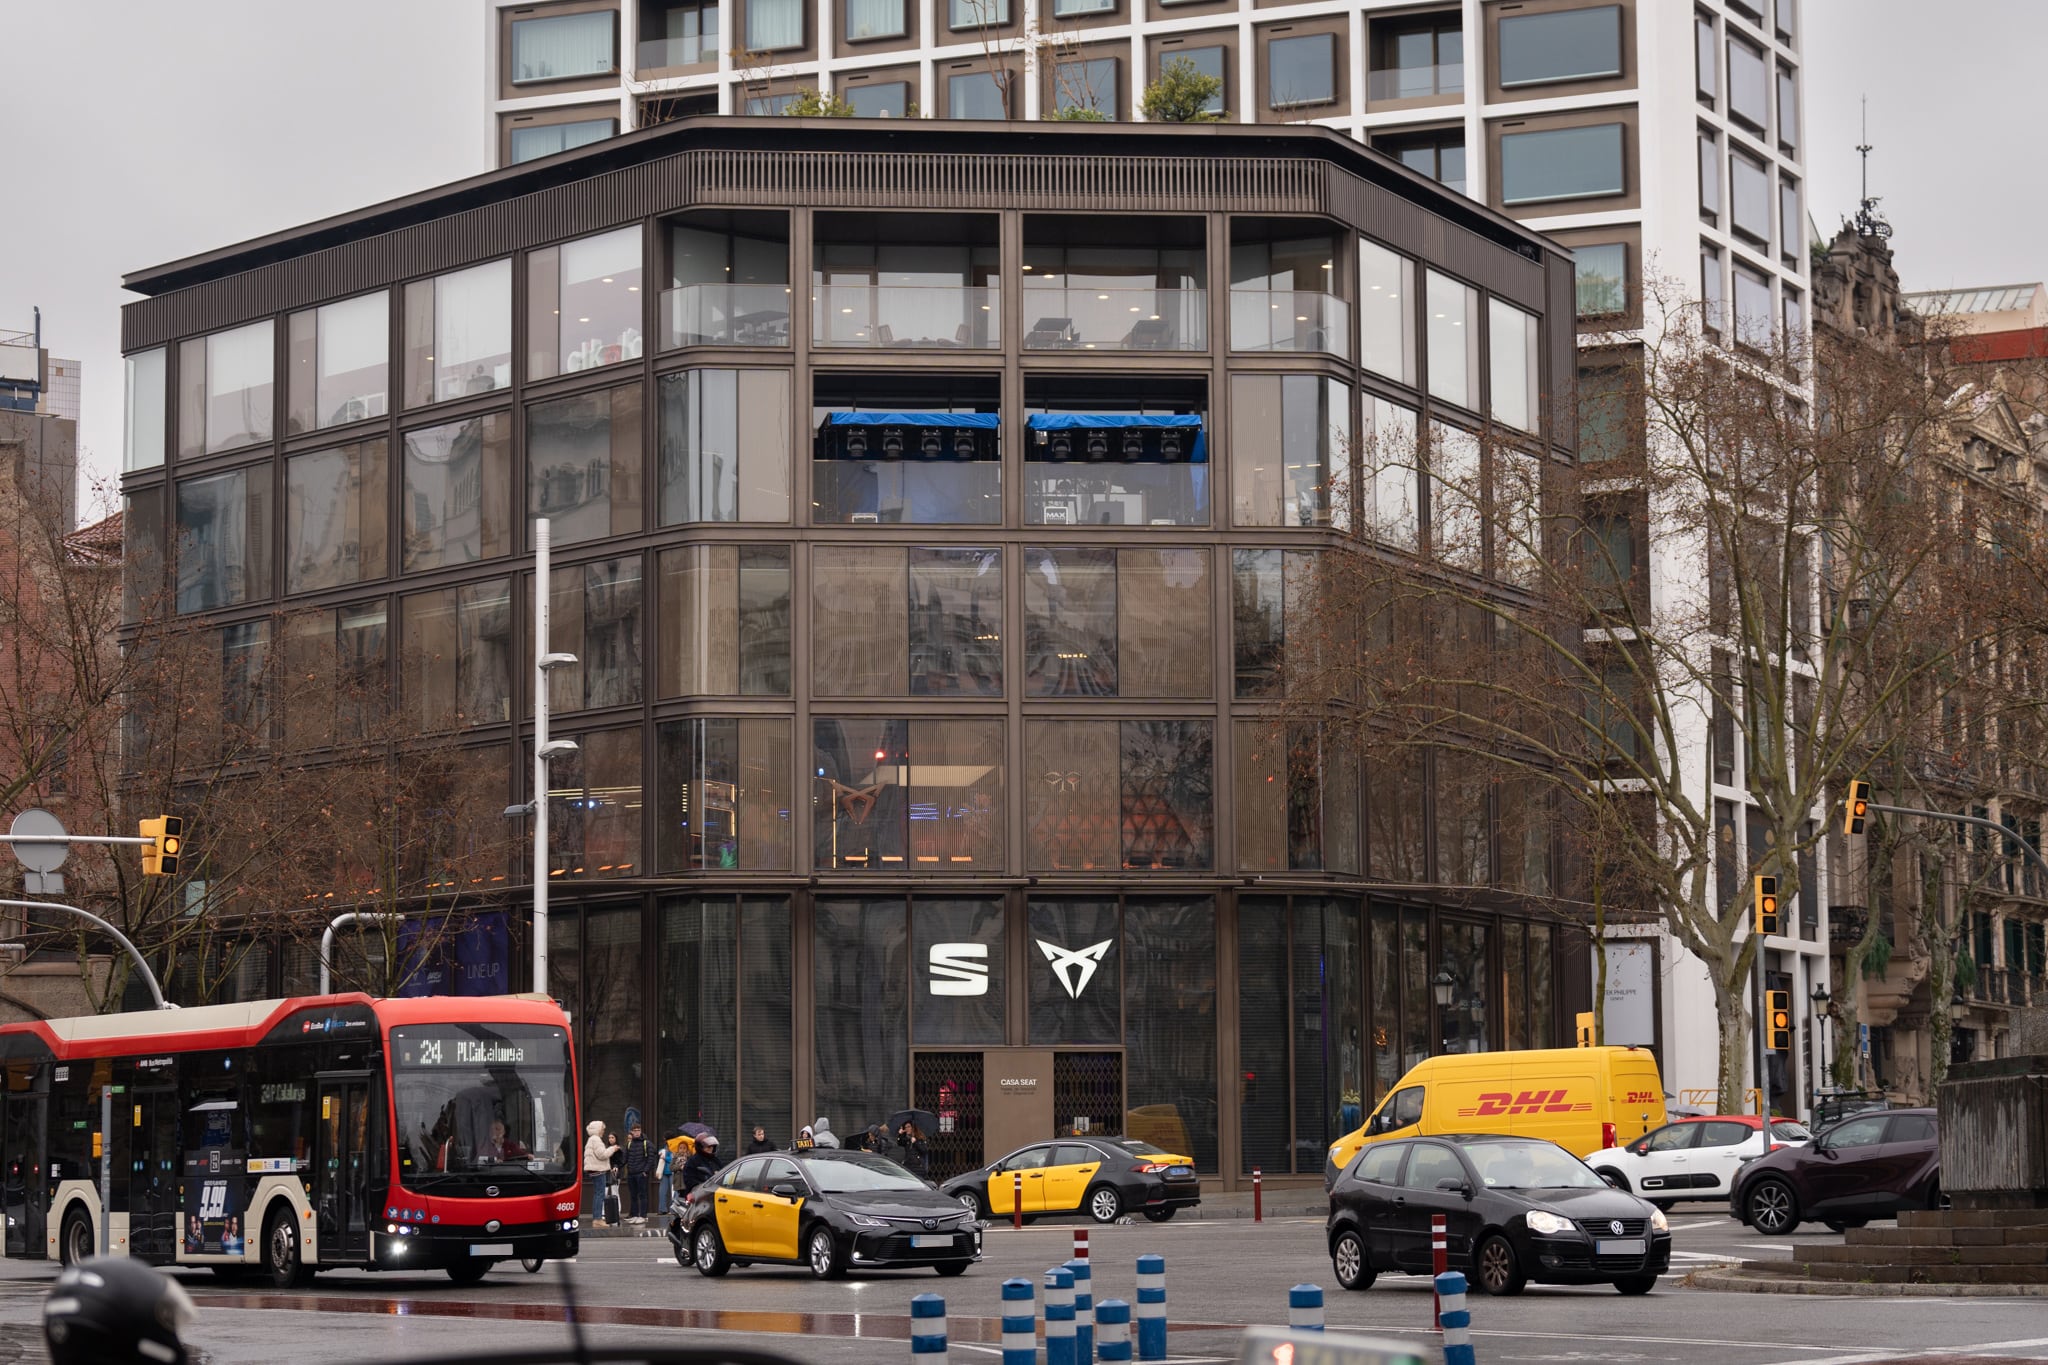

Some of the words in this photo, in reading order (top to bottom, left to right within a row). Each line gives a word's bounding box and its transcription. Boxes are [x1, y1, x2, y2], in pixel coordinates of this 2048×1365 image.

[467, 964, 486, 979] LINE
[487, 962, 500, 978] UP
[420, 1040, 443, 1064] 24
[1000, 1078, 1020, 1086] CASA
[1020, 1078, 1038, 1086] SEAT
[1476, 1089, 1574, 1116] DHL
[1627, 1092, 1655, 1104] DHL
[556, 1202, 575, 1211] 4603
